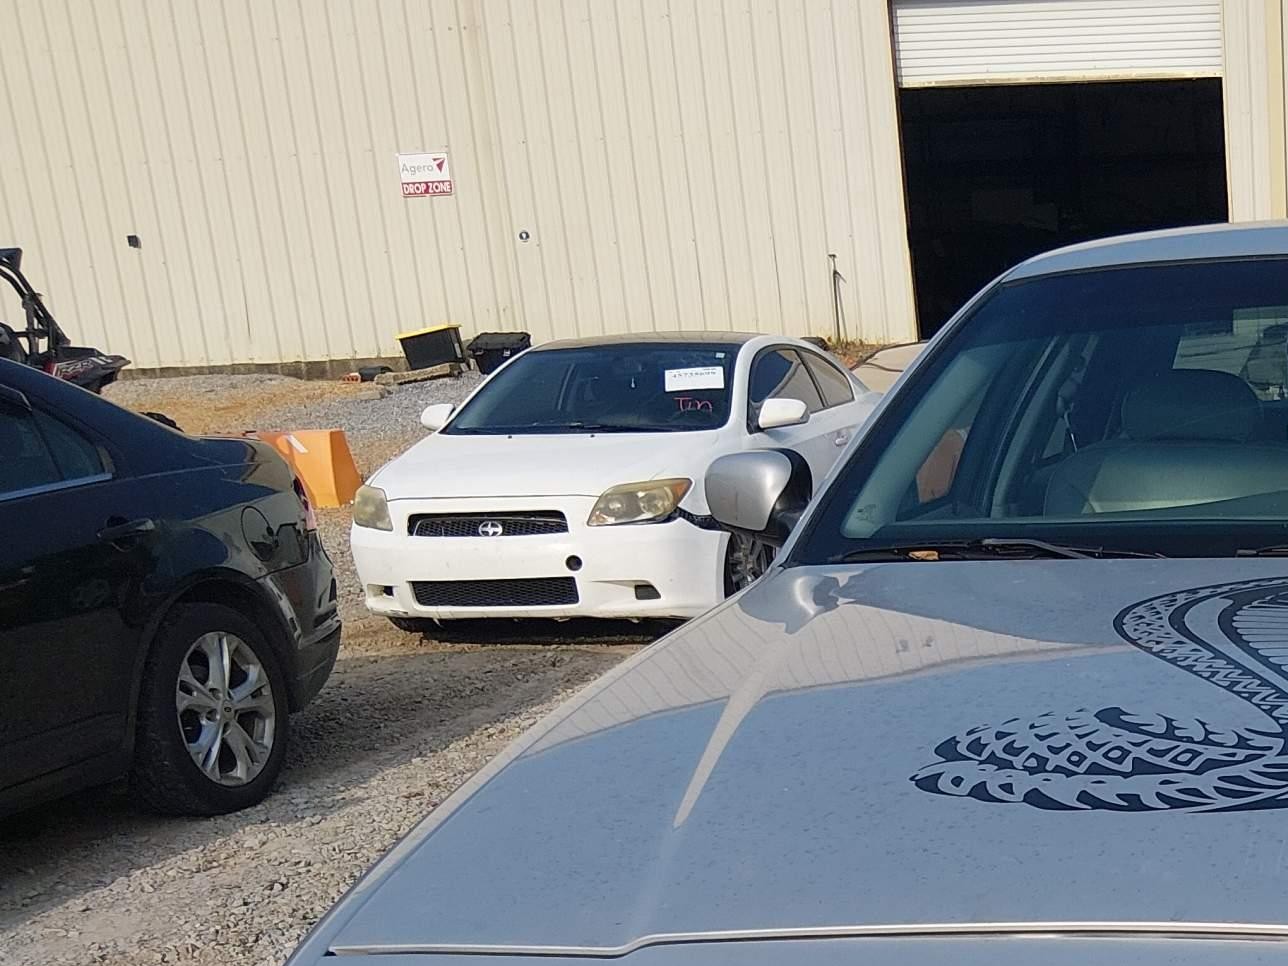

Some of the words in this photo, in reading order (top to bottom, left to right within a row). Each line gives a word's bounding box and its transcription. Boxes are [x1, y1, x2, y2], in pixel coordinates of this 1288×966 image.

[401, 163, 434, 176] Agero
[402, 183, 427, 194] DROP
[428, 182, 451, 193] ZONE
